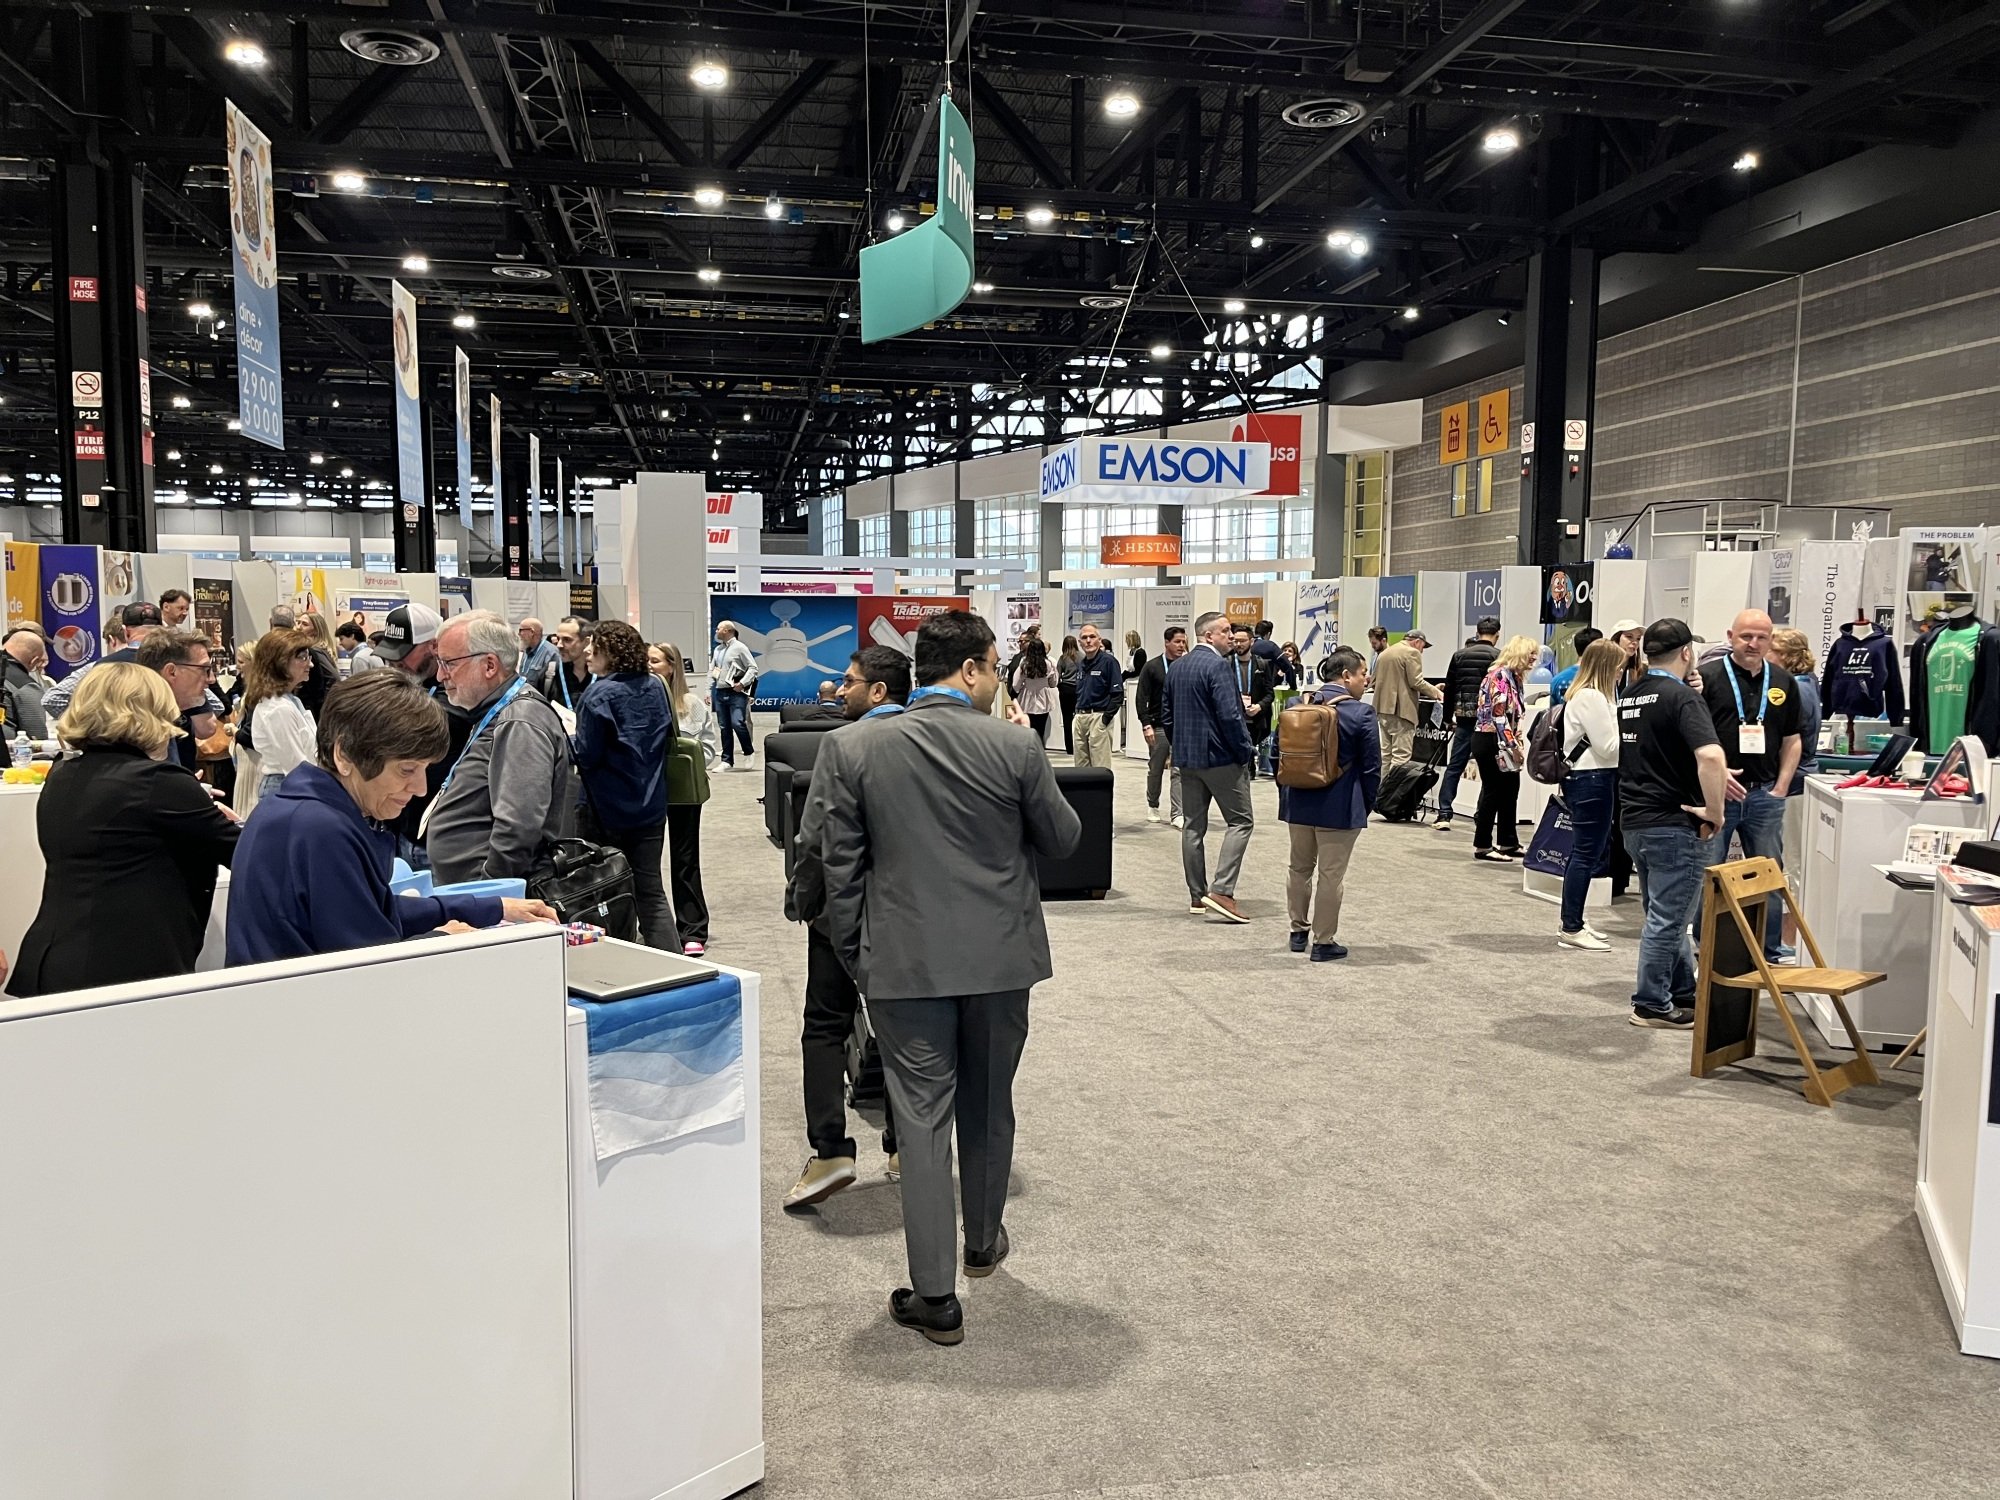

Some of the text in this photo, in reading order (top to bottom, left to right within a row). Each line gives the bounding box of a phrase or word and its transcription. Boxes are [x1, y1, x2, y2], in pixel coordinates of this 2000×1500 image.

[74, 280, 94, 289] FIRE
[73, 290, 96, 298] HOSE
[240, 302, 256, 328] dine
[240, 328, 262, 354] décor
[242, 367, 276, 406] 2900
[79, 410, 100, 420] P12
[244, 399, 278, 436] 3000
[78, 436, 104, 444] FIRE
[76, 445, 105, 454] HOSE
[1042, 448, 1076, 496] EMSON
[1100, 444, 1246, 486] EMSON
[708, 529, 730, 543] oil
[1125, 543, 1176, 553] HESTAN
[1826, 564, 1838, 588] The
[1076, 592, 1104, 603] Jordan
[1300, 584, 1323, 599] Better
[1230, 602, 1258, 615] Coit's
[1380, 593, 1412, 612] mitty
[1822, 592, 1836, 656] Organized
[1848, 652, 1869, 664] hi!
